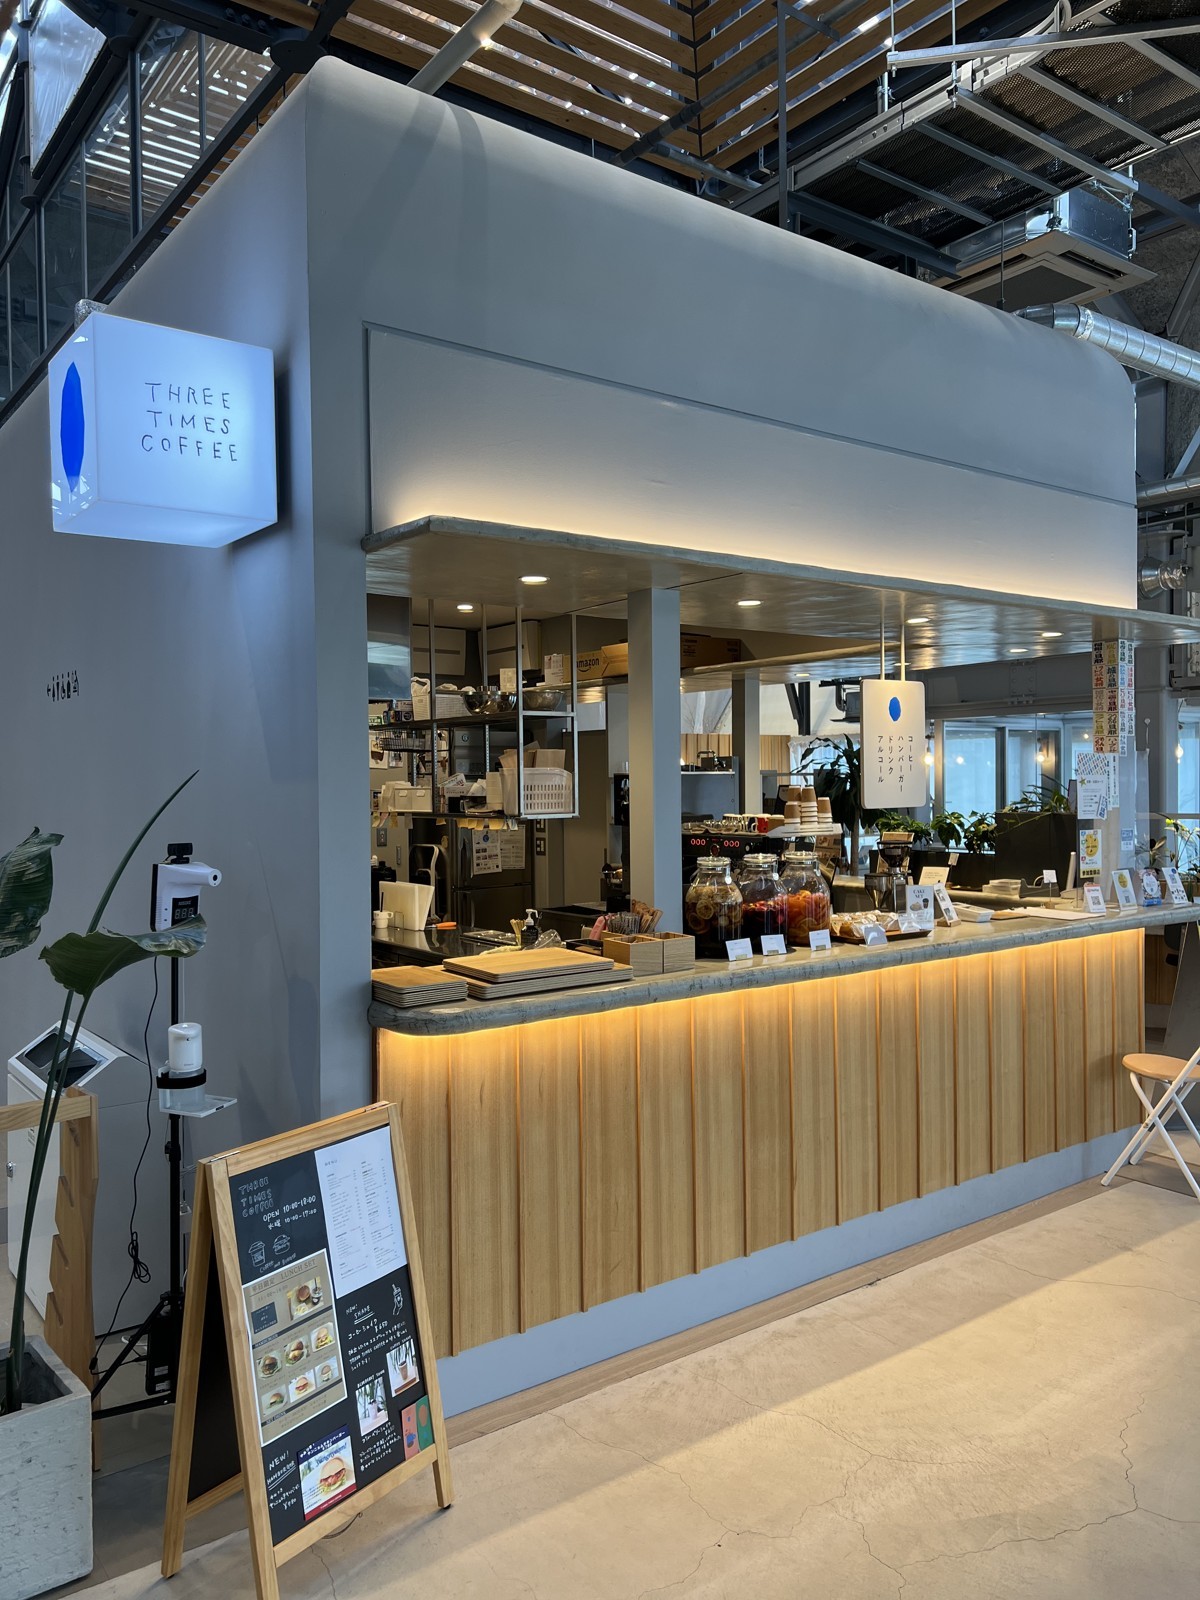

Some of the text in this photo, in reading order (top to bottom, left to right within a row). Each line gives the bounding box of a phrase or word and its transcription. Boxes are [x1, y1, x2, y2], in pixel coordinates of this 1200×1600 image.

[145, 382, 232, 410] THREE
[146, 410, 231, 435] TIMES
[141, 434, 238, 462] COFFEE
[240, 1188, 272, 1207] TIMES
[262, 1209, 280, 1222] OPEN
[280, 1263, 304, 1279] LUNCH
[304, 1258, 317, 1269] SET
[268, 1450, 290, 1471] NEW!
